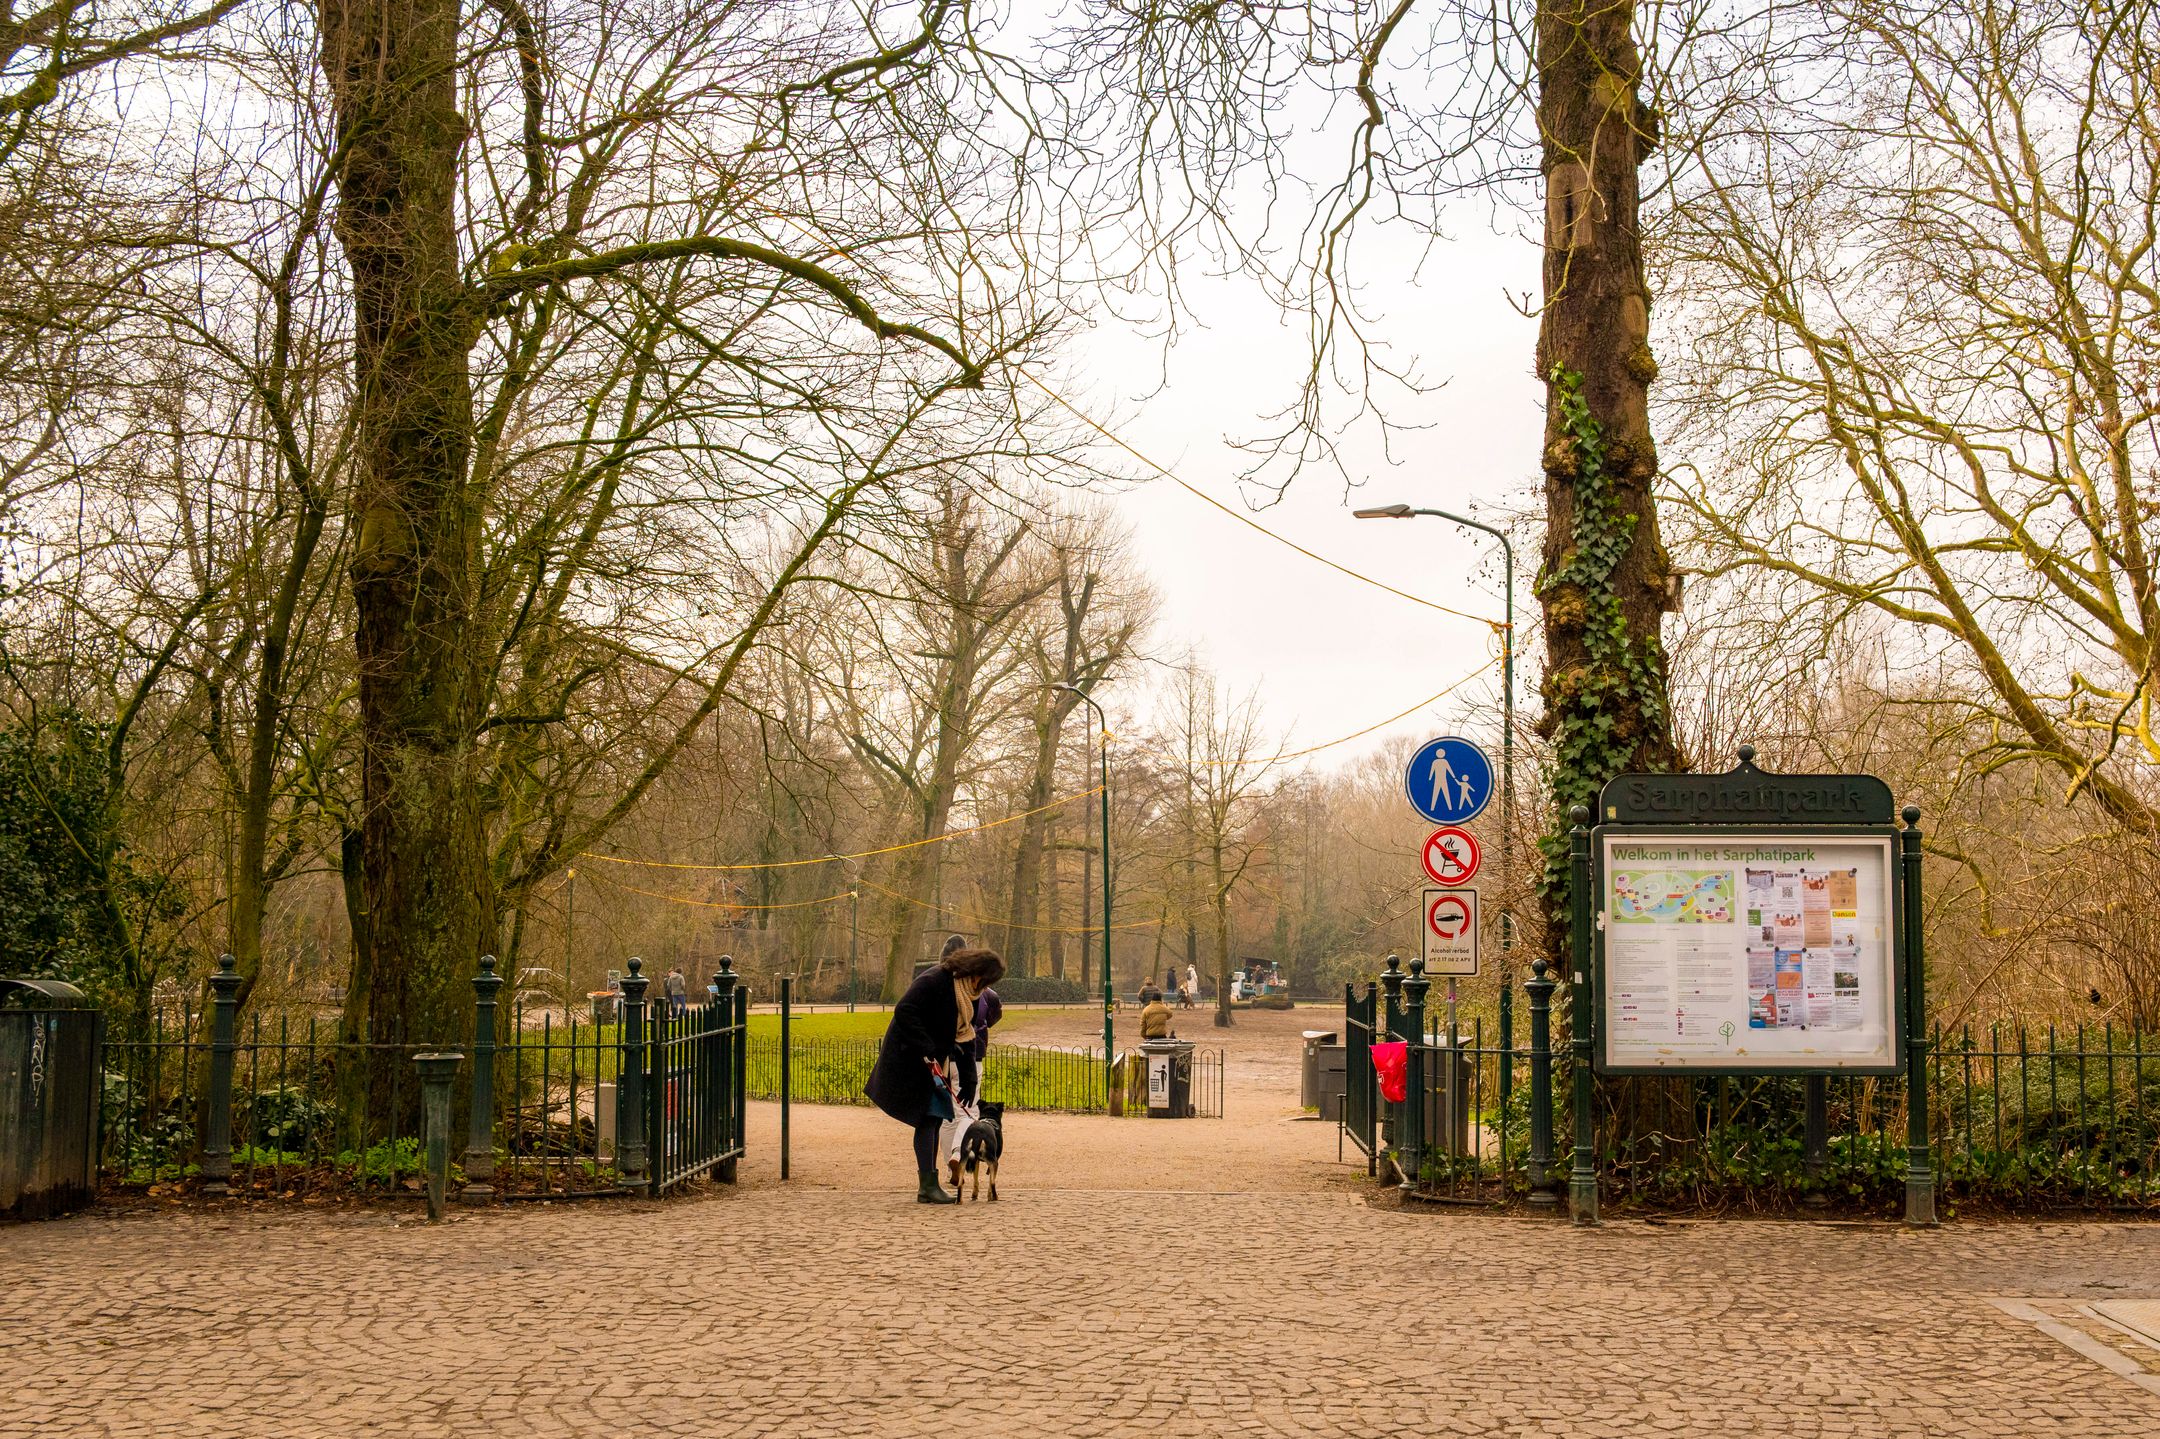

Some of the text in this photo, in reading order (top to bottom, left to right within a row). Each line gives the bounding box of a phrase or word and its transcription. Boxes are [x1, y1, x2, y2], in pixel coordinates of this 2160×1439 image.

[1627, 782, 1866, 819] Sarphatipark
[1613, 848, 1815, 864] Welkom in het Sarphatipark
